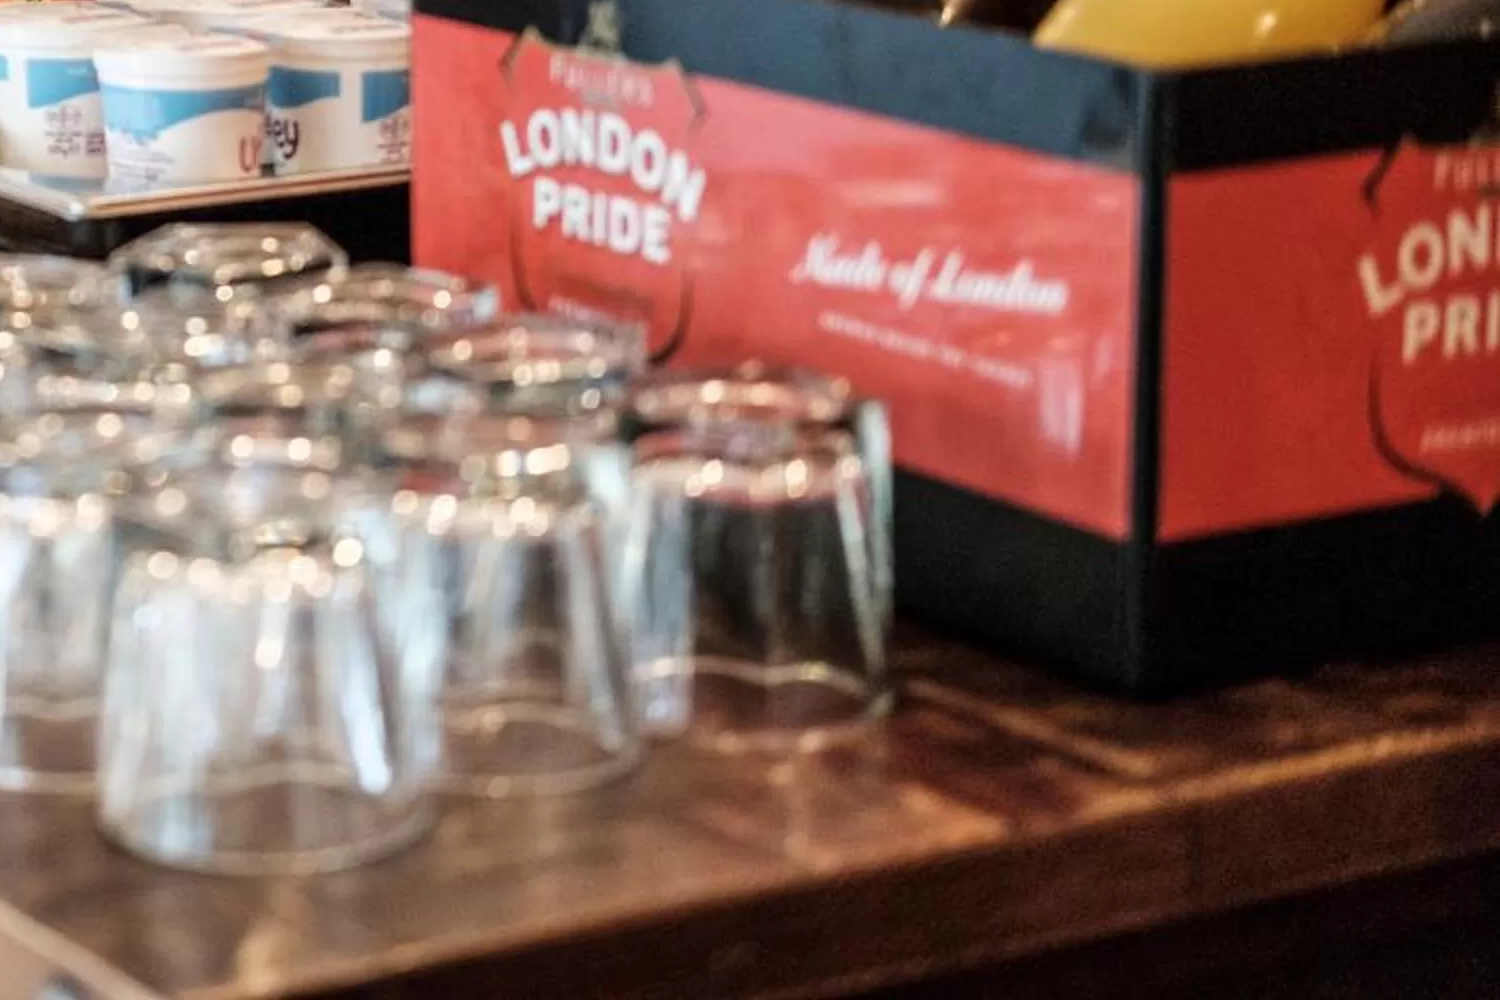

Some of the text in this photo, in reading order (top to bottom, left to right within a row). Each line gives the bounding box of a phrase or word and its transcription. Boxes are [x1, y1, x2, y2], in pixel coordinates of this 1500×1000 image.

[499, 106, 707, 223] LONDON
[532, 174, 672, 267] PRIDE
[1356, 202, 1500, 318] LON
